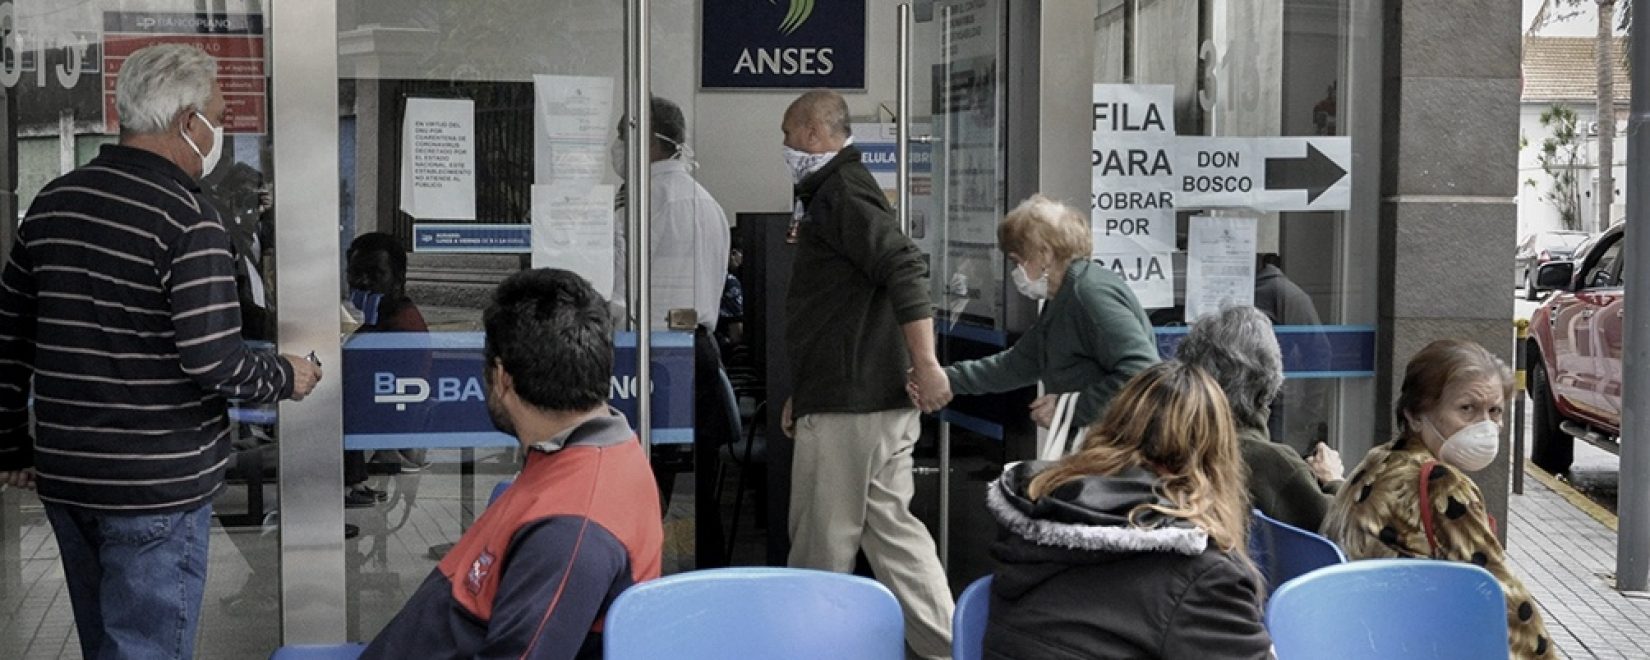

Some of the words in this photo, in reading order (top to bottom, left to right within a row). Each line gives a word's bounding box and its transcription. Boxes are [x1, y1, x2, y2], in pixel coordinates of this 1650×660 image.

[732, 48, 834, 75] ANSES
[1092, 103, 1166, 131] FILA
[1198, 151, 1239, 168] DON
[1182, 176, 1252, 192] BOSCO
[1106, 218, 1150, 236] POR
